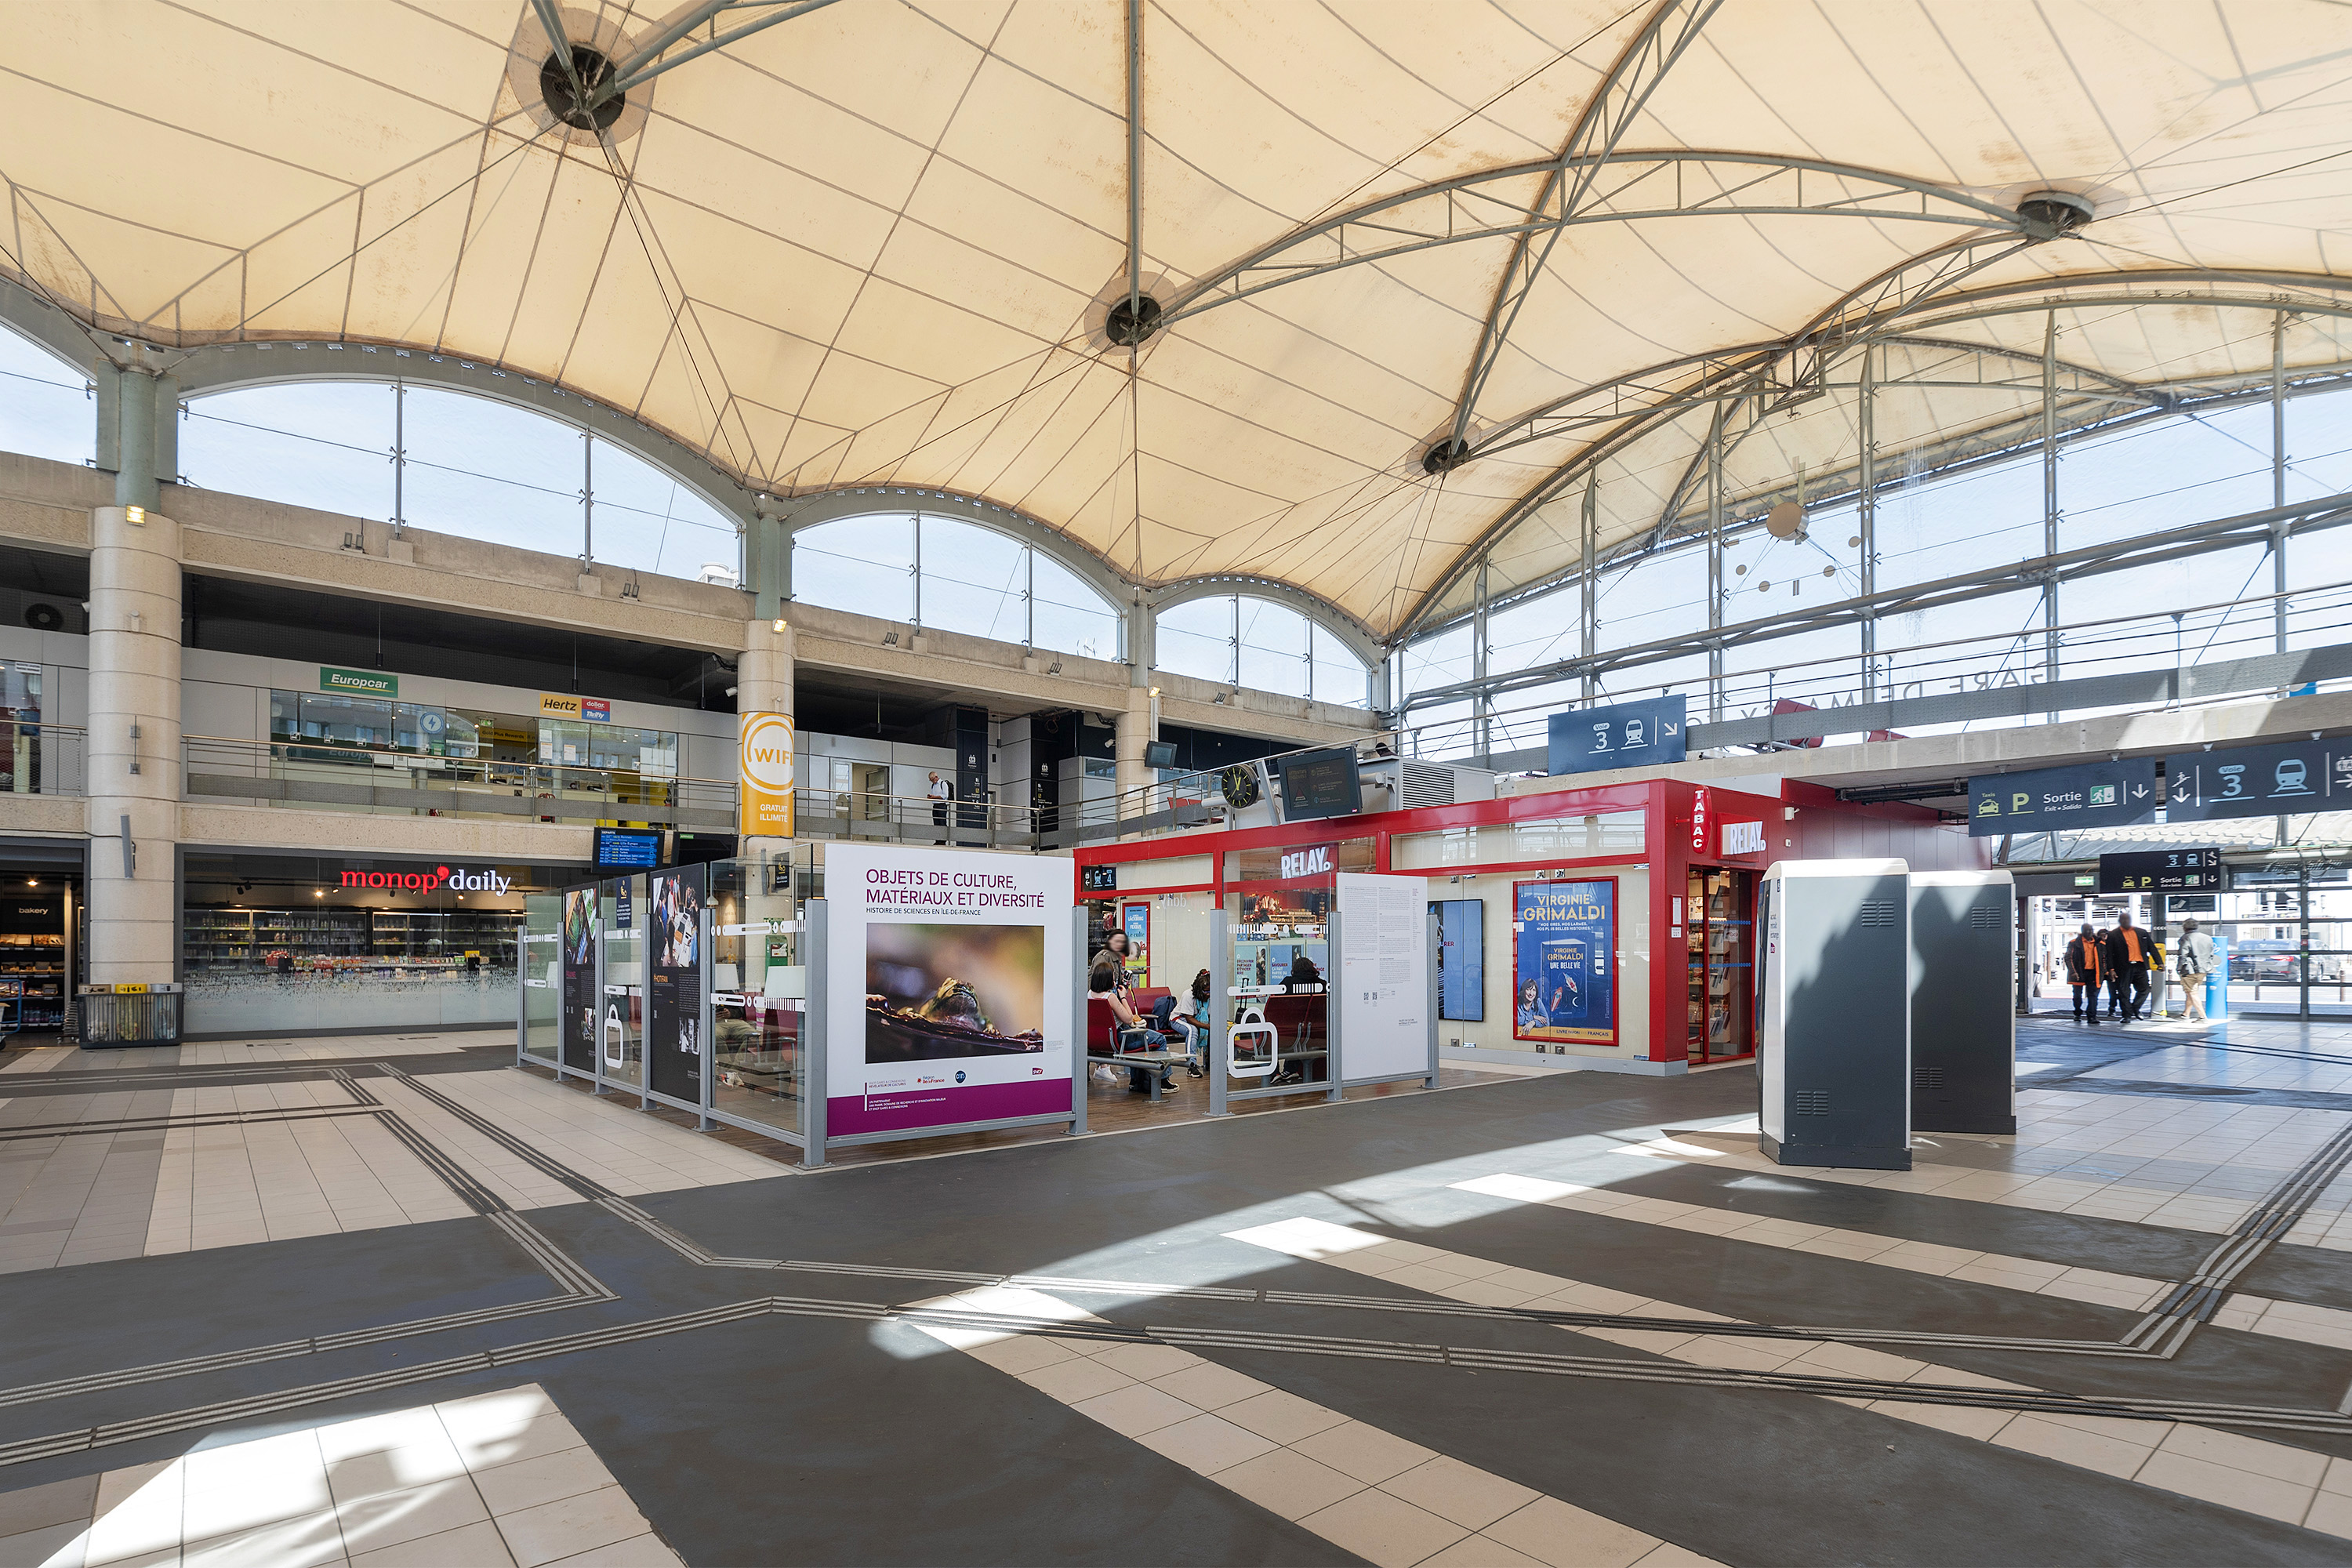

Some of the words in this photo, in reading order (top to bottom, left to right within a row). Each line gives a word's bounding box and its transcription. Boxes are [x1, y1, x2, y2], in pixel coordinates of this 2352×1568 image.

[331, 673, 389, 689] Europcar
[543, 699, 577, 711] Hertz
[1595, 731, 1608, 750] 3
[753, 748, 793, 767] WIFI
[2222, 775, 2242, 797] 3
[2013, 793, 2031, 812] P
[2043, 791, 2082, 804] Sortie
[760, 804, 788, 813] GRATUIT
[760, 813, 788, 822] ILLIMITÉ
[1693, 789, 1704, 848] TABAC
[1730, 821, 1763, 855] RELAY
[1280, 846, 1328, 880] RELAY
[866, 868, 924, 885] OBJETS
[929, 872, 949, 886] DE
[953, 873, 1017, 891] CULTURE,
[1106, 874, 1112, 884] 4
[2141, 877, 2151, 887] P
[866, 887, 953, 906] MATÉRIAUX
[957, 892, 975, 906] ET
[979, 892, 1044, 908] DIVERSITÉ
[1537, 894, 1590, 906] VIRGINIE
[941, 907, 981, 916] ÎLE-DE-FRANCE
[1523, 906, 1606, 921] GRIMALDI
